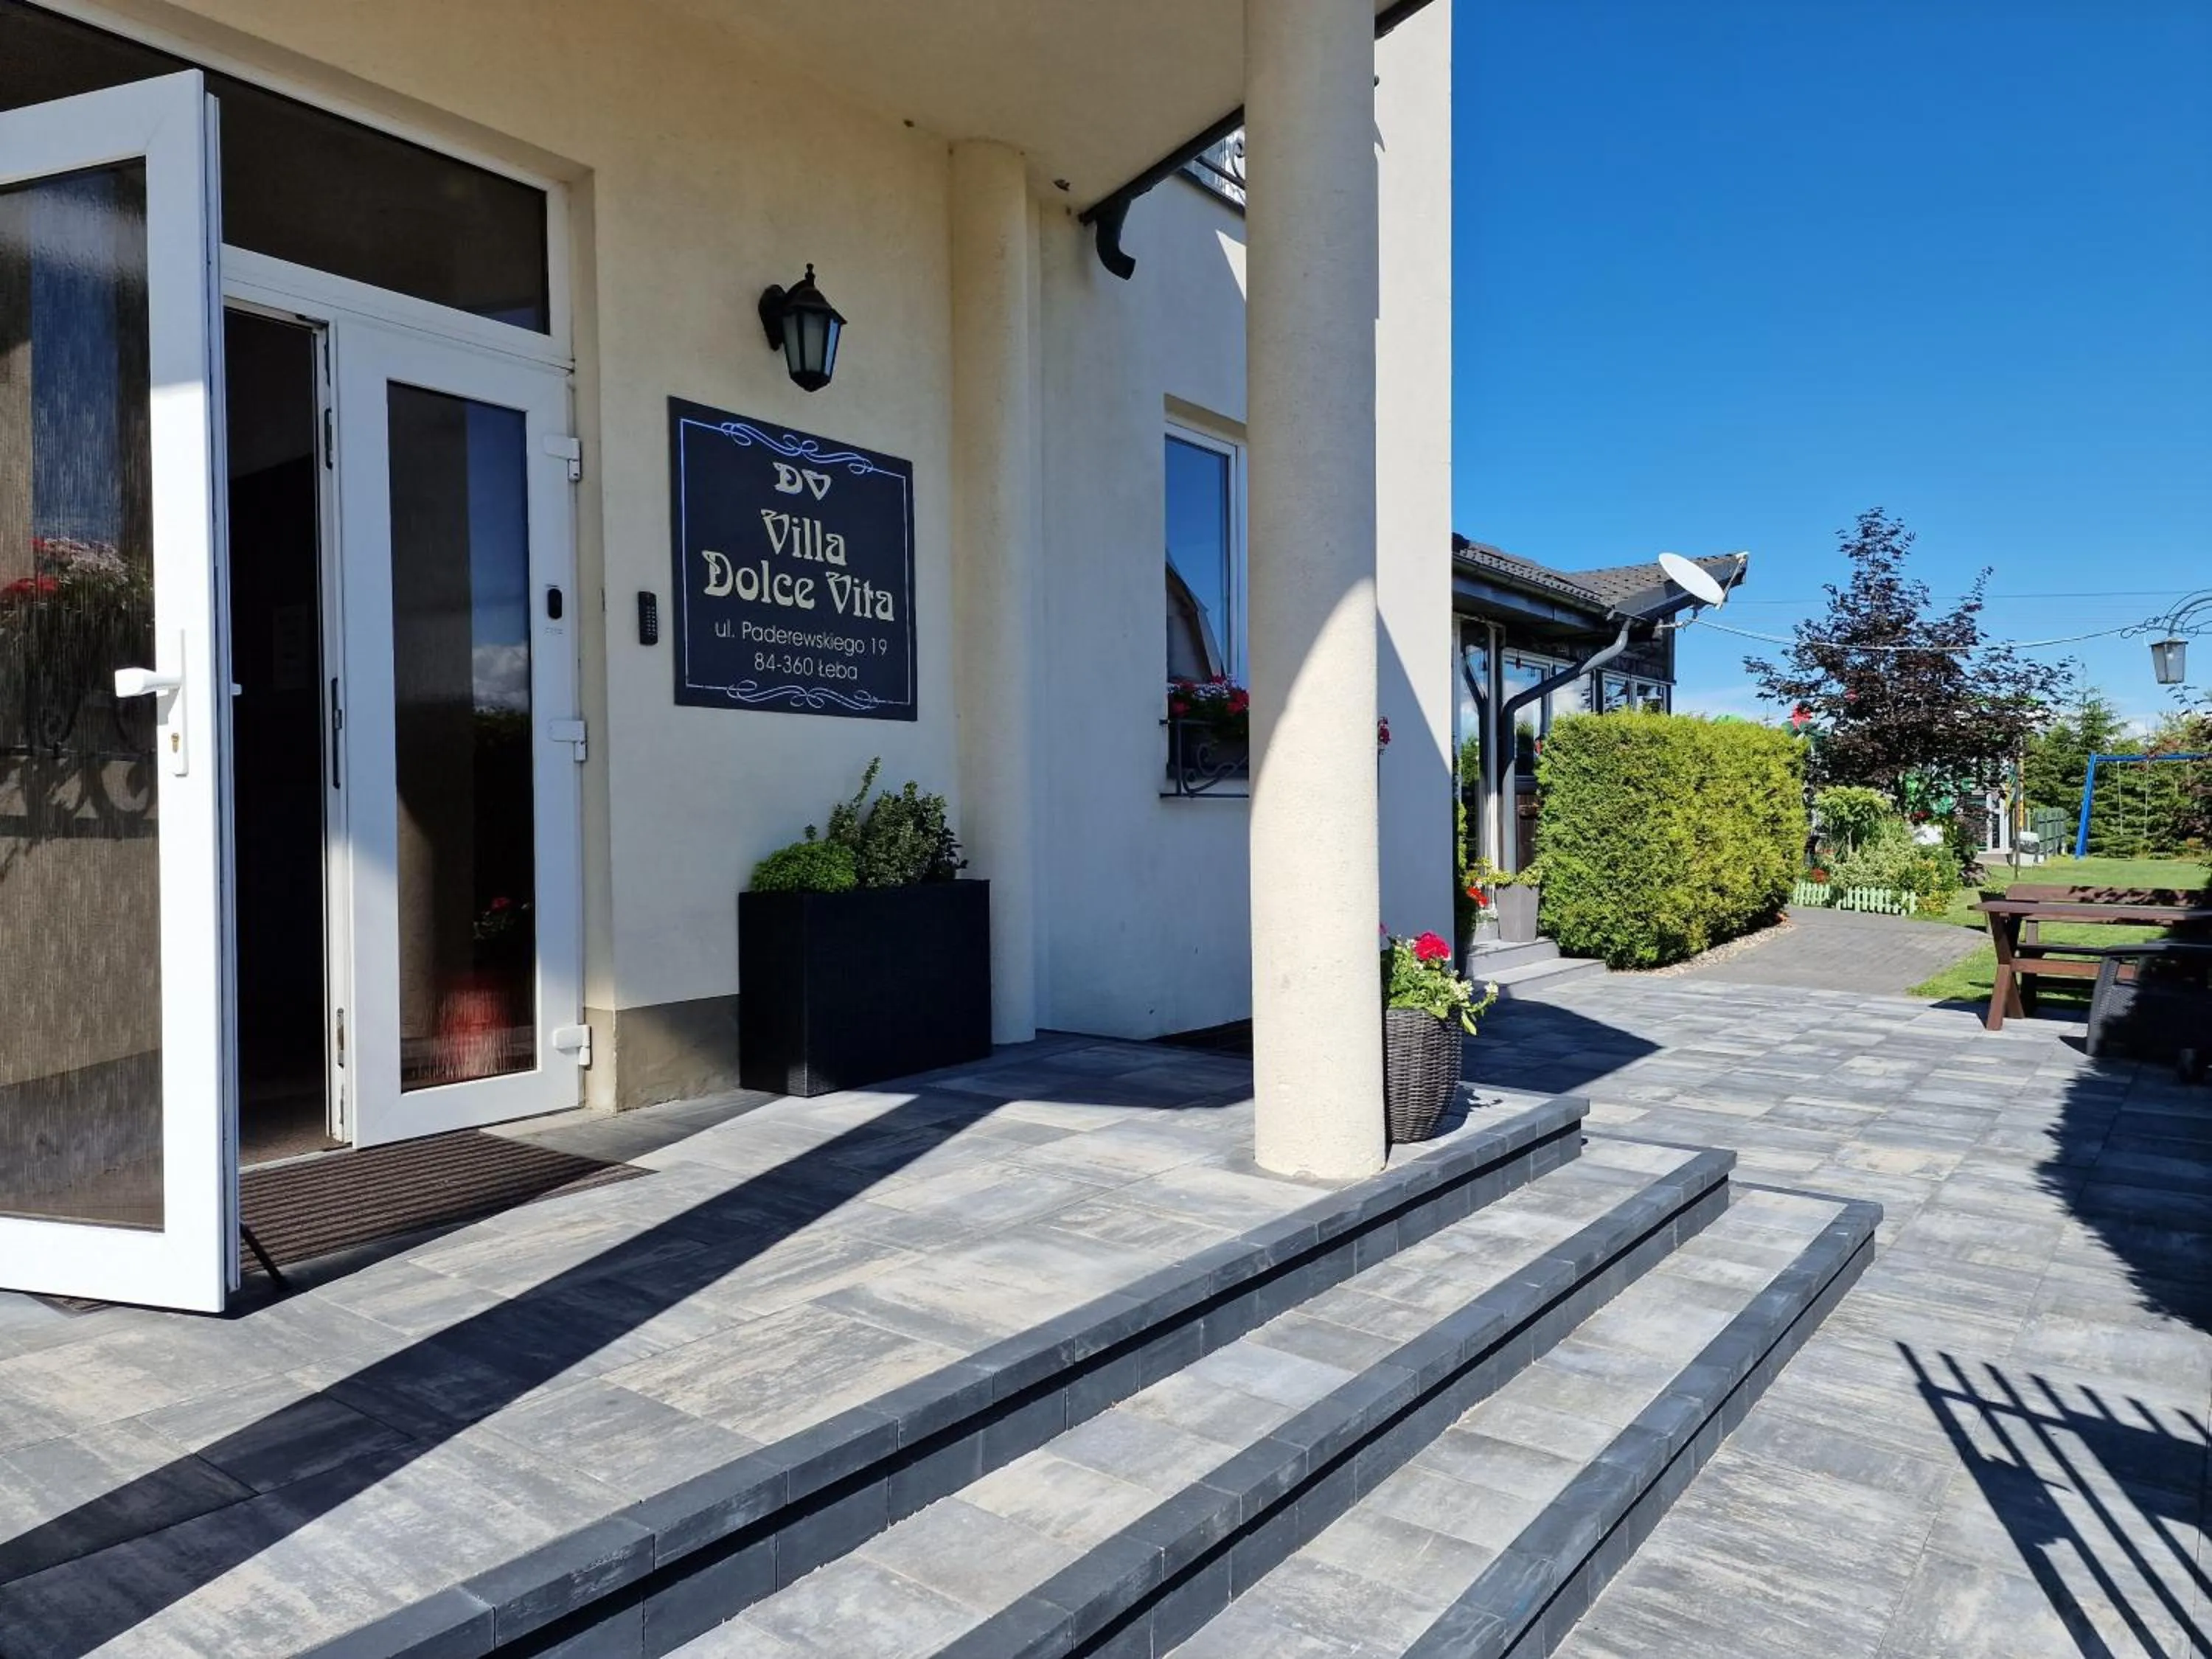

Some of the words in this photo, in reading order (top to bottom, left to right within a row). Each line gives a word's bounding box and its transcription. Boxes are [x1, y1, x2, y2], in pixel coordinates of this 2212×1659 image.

[760, 509, 847, 566] Villa
[701, 549, 815, 610] Dolce
[825, 571, 895, 622] Vita
[714, 619, 735, 639] ul.
[742, 622, 865, 656] Paderewskiego
[871, 637, 887, 655] 19
[754, 652, 813, 676] 84-360
[818, 659, 858, 681] Łeba
